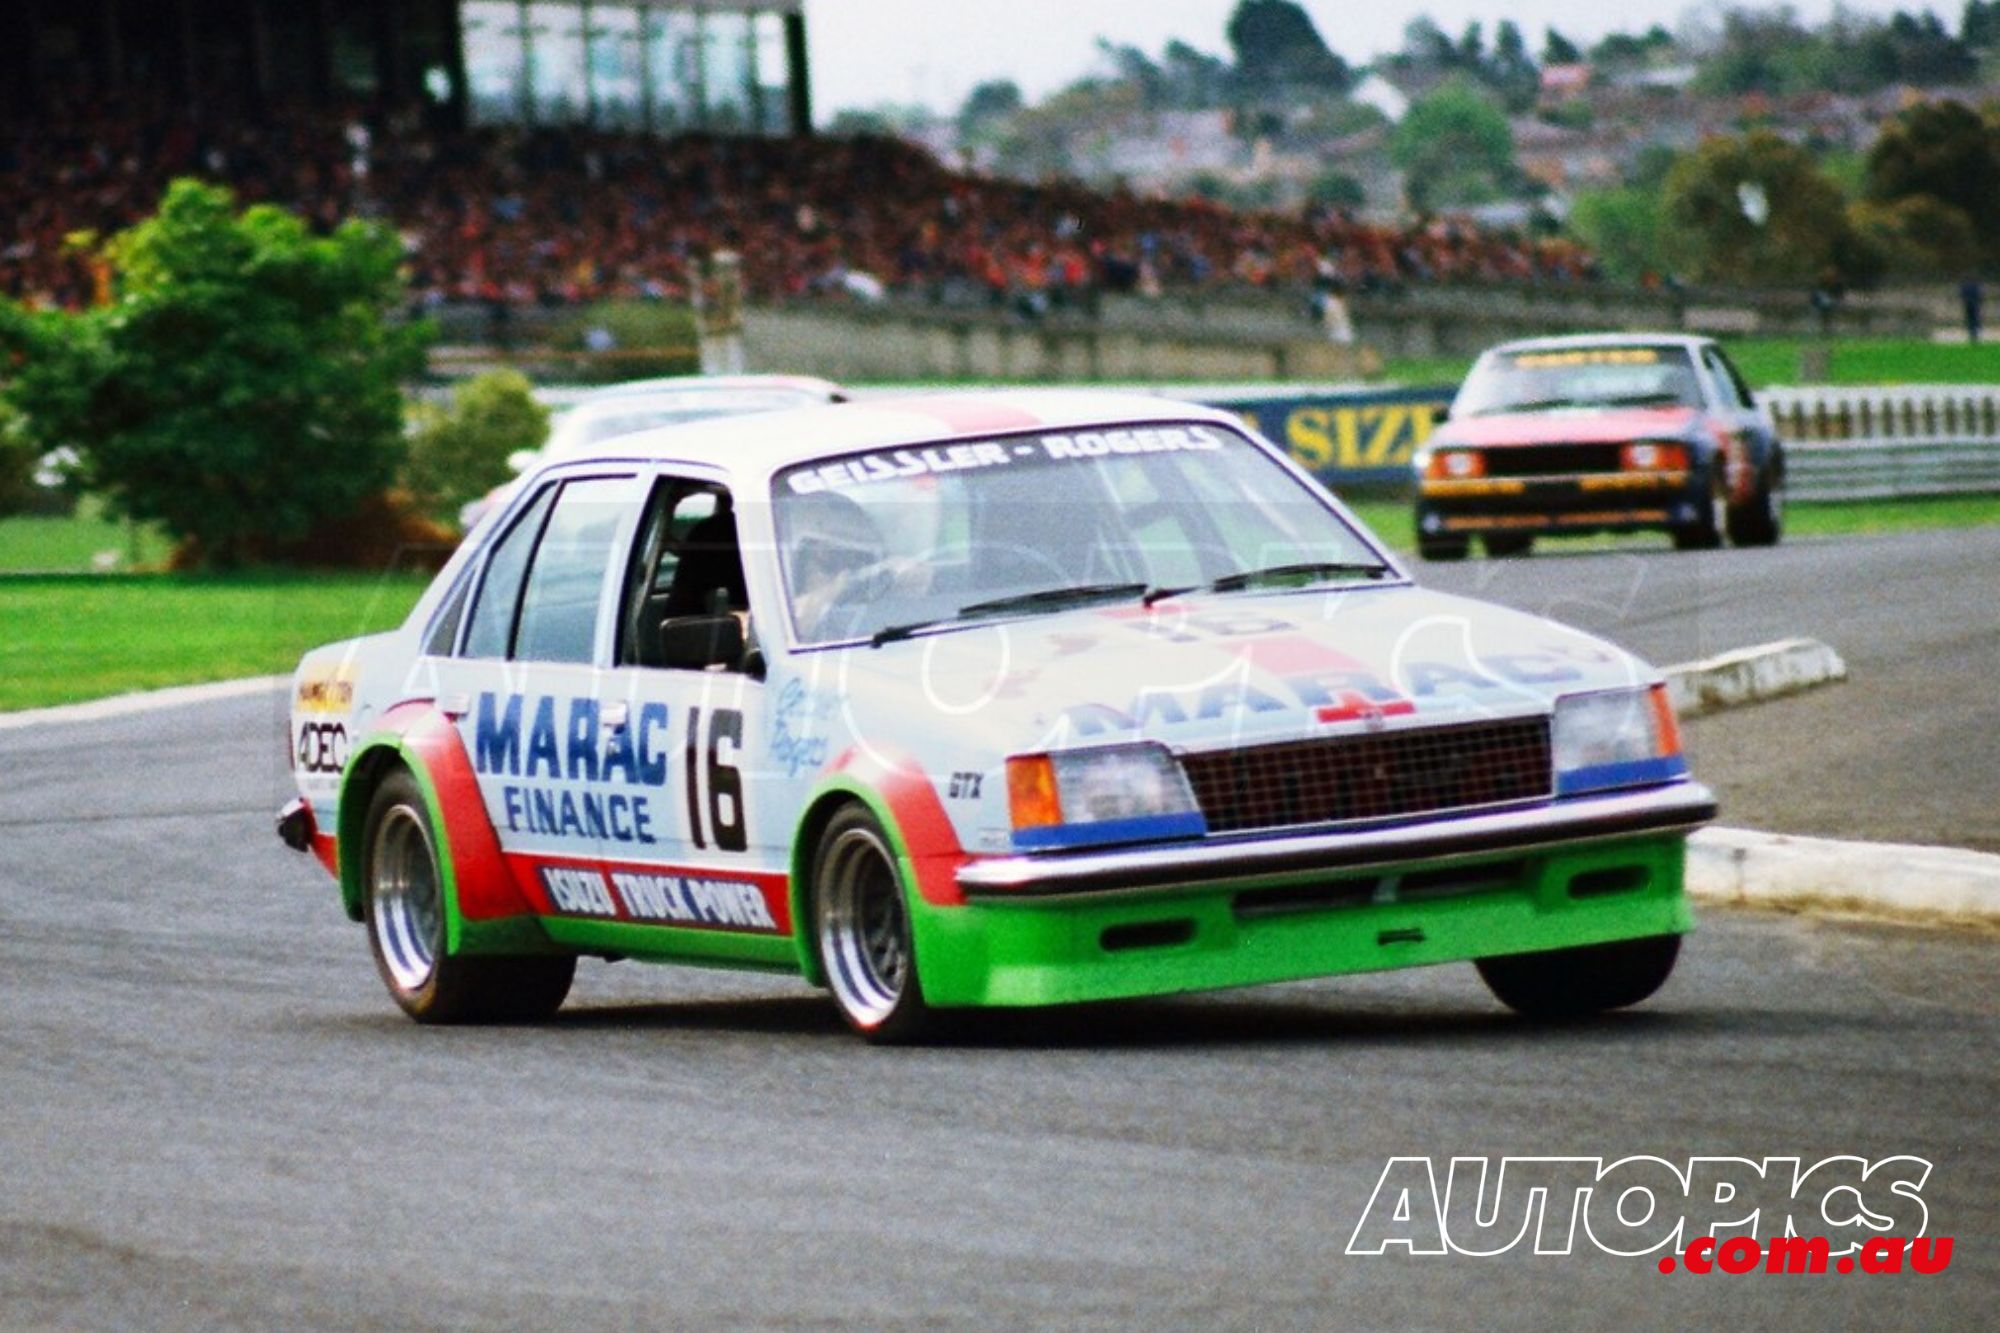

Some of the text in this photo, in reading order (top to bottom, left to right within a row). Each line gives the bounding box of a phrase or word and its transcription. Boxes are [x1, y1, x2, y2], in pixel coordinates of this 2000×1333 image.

[788, 443, 1009, 493] GEISSLER
[1045, 424, 1223, 459] ROGERS
[475, 691, 668, 787] MARAC
[685, 705, 748, 852] 16
[948, 770, 985, 799] GTX
[504, 785, 657, 844] FINANCE
[543, 866, 777, 930] ISUZU TRUCK POWER
